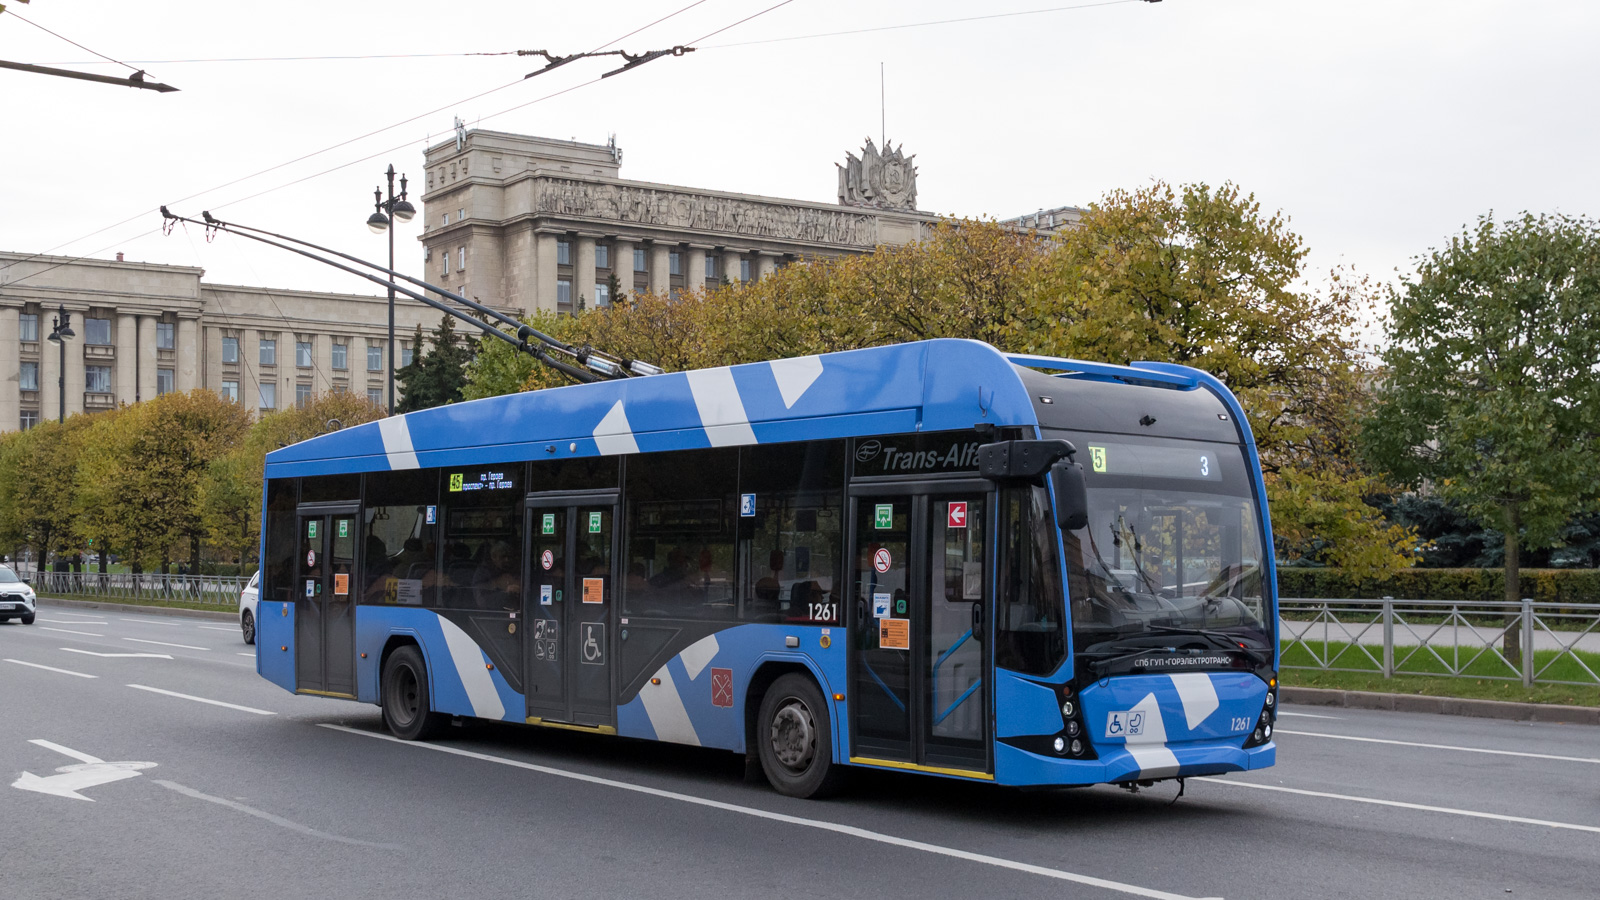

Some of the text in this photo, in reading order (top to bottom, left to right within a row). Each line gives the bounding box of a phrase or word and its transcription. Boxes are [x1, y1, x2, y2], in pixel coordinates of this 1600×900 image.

[1200, 456, 1209, 477] 3
[451, 474, 461, 490] 45
[385, 582, 398, 602] 45
[808, 603, 837, 621] 1261
[1150, 657, 1165, 667] ГУП
[1231, 717, 1250, 731] 1261
